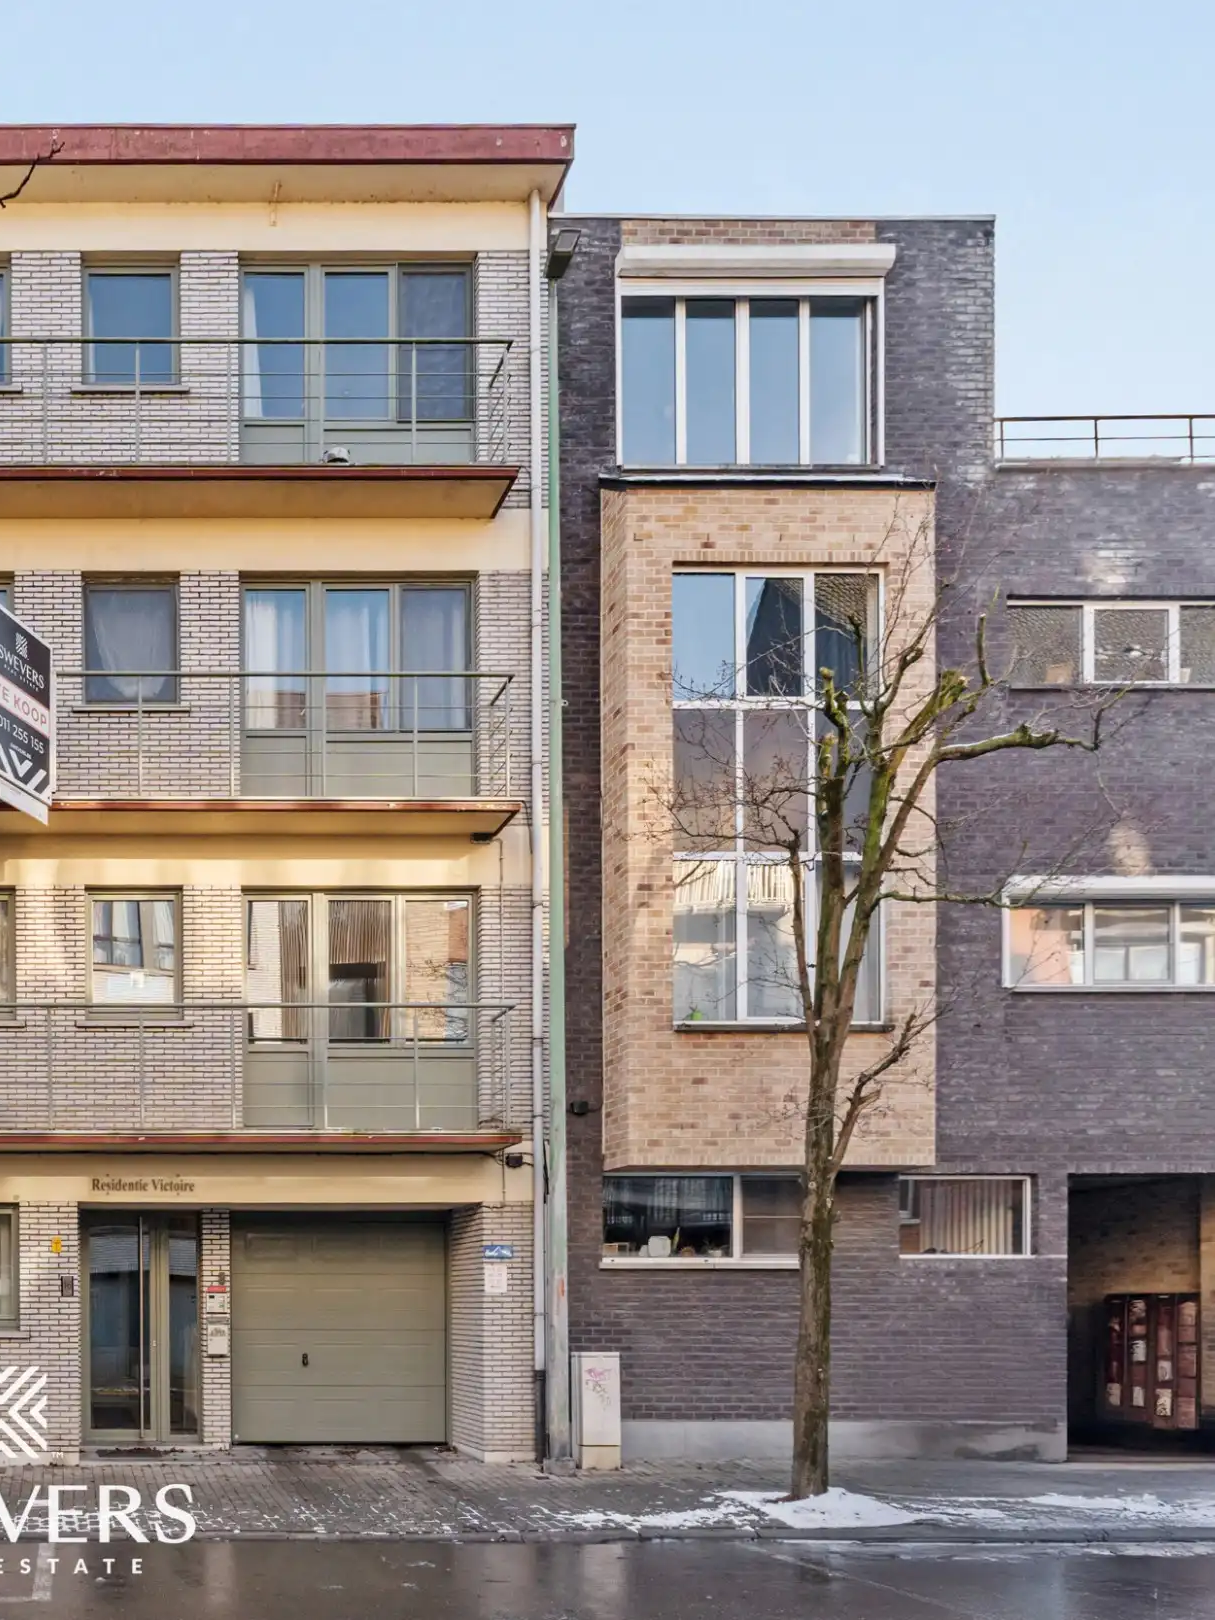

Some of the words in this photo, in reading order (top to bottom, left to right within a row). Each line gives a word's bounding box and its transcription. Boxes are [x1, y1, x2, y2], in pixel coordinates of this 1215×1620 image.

[13, 693, 47, 726] KOOP
[13, 724, 29, 744] 255
[30, 735, 44, 754] 155
[91, 1178, 149, 1192] Residentie
[152, 1178, 195, 1192] Victoire
